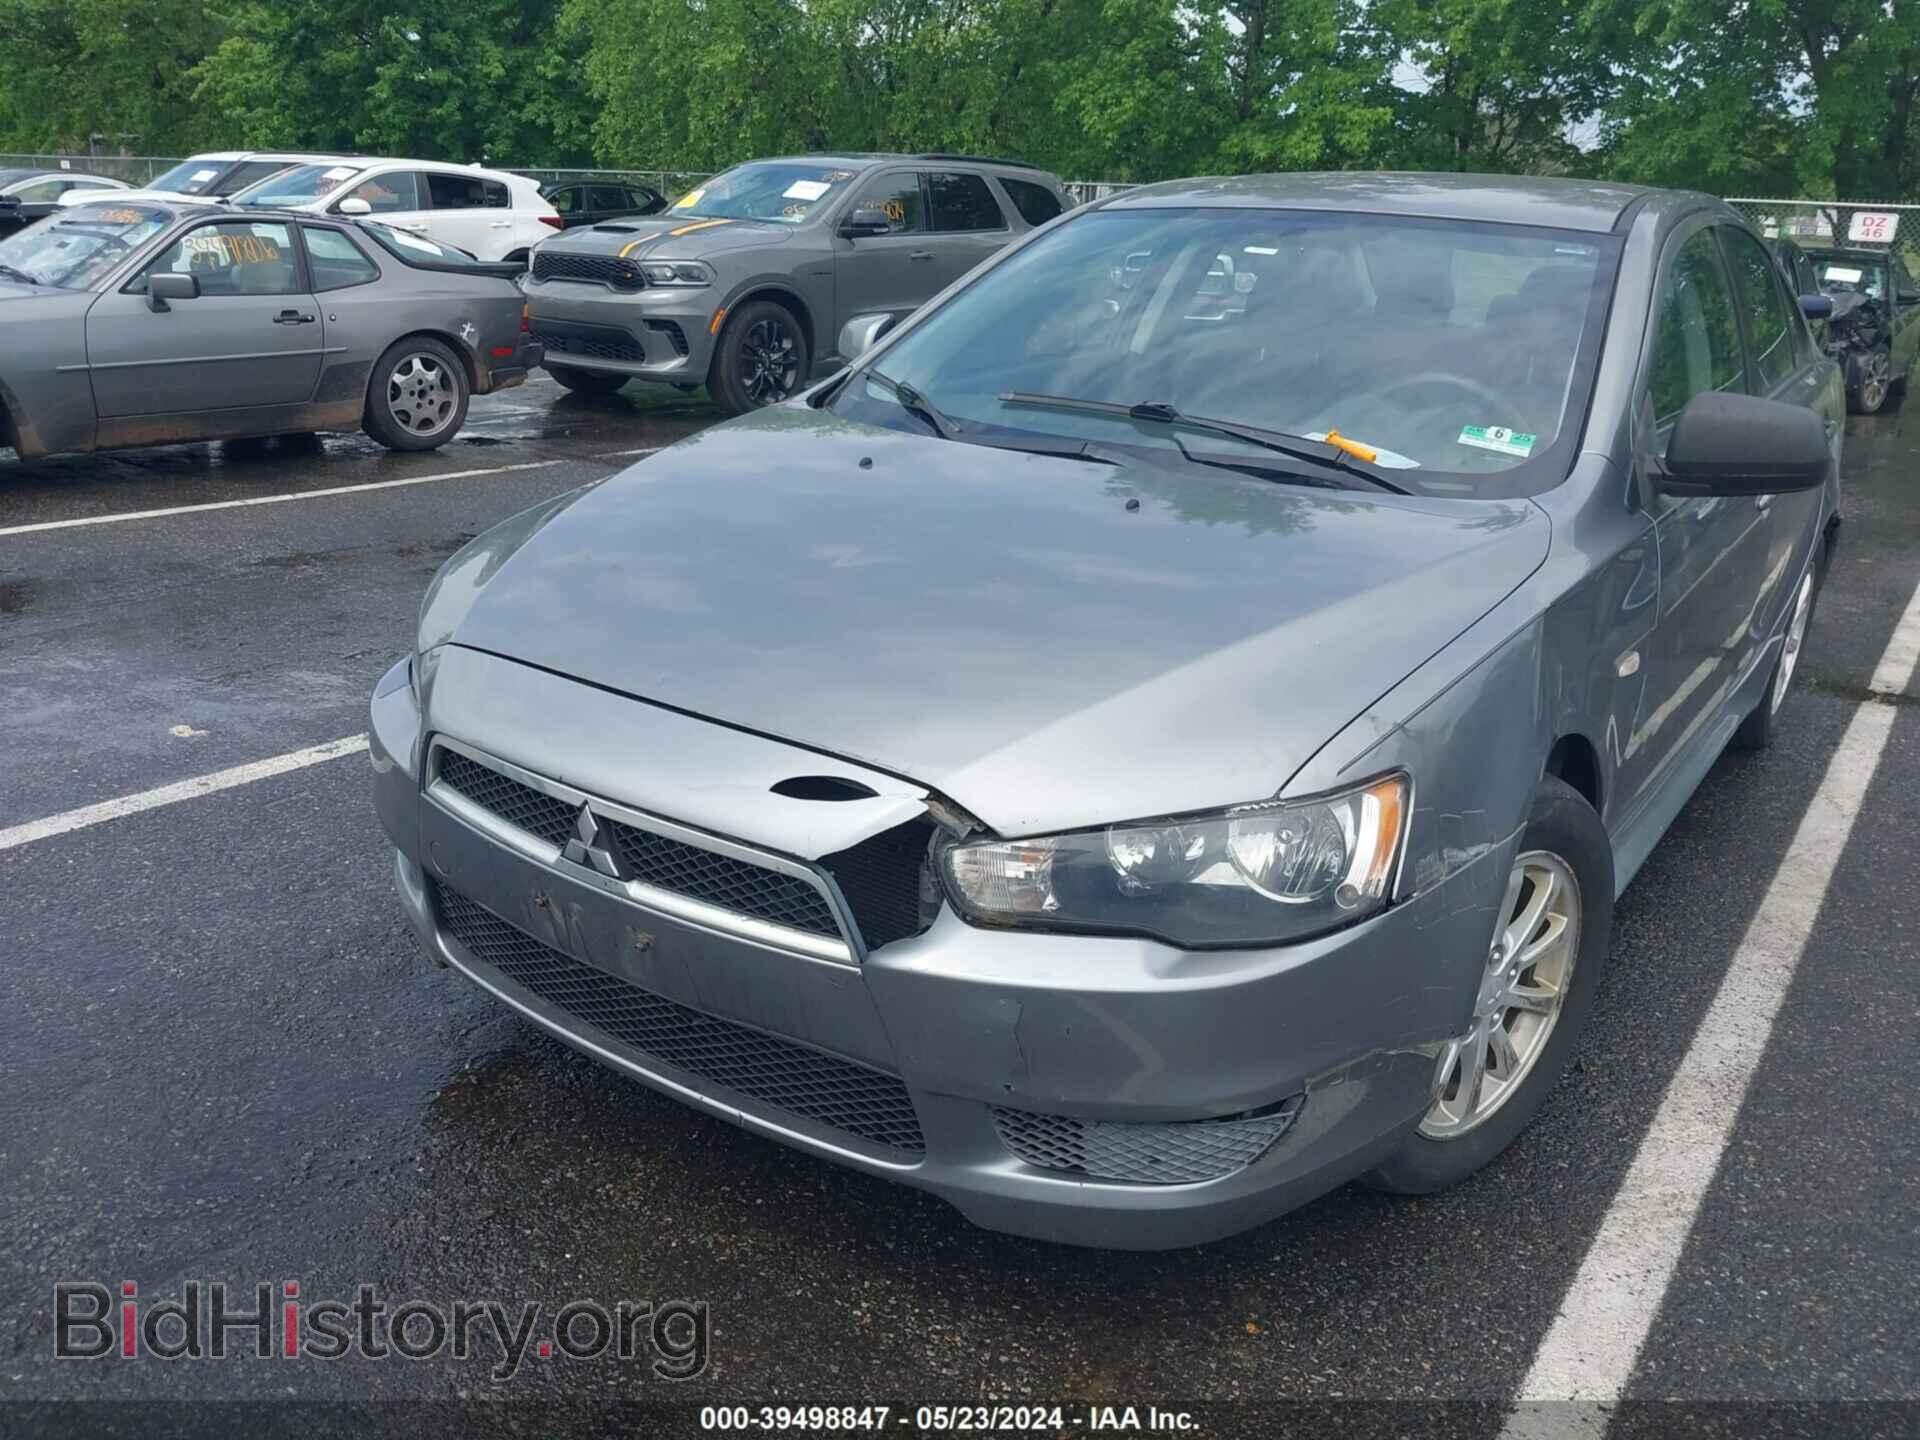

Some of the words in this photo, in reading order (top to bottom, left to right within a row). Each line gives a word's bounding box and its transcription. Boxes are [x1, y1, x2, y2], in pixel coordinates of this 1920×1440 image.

[1863, 217, 1887, 227] DZ
[1862, 229, 1882, 238] 46
[1494, 428, 1504, 439] 6
